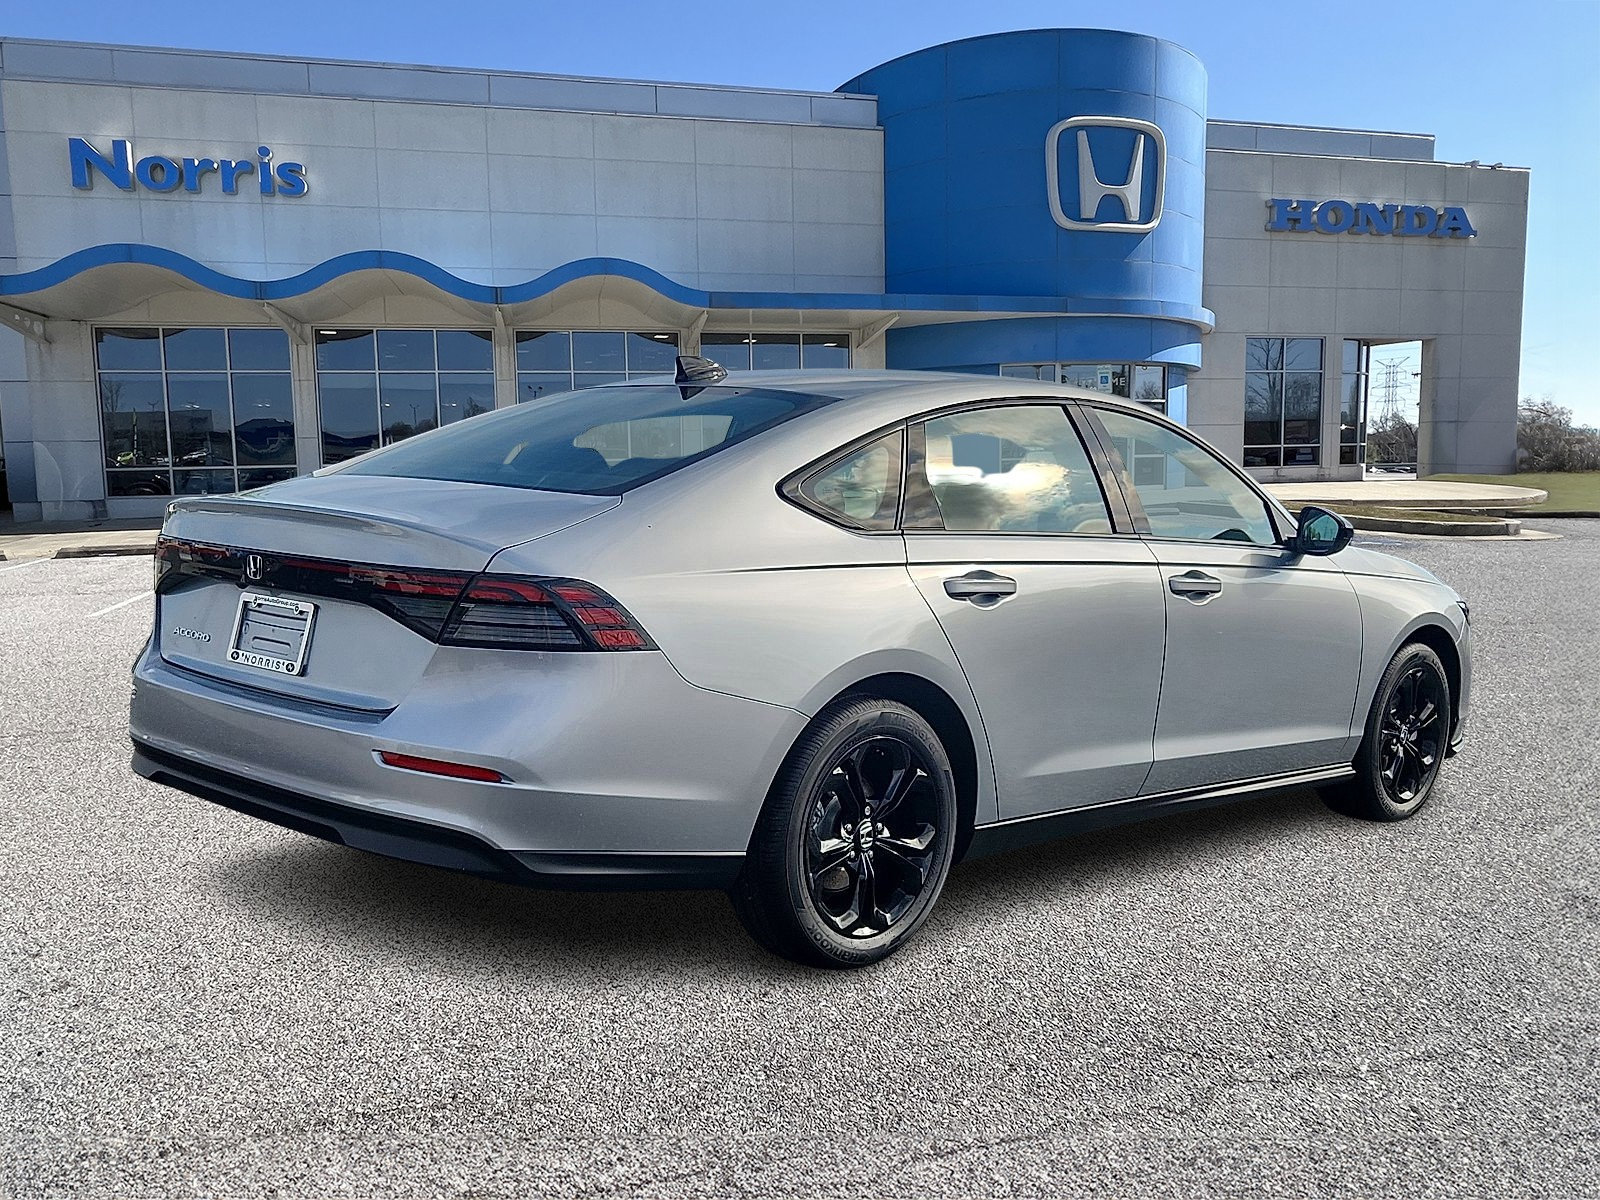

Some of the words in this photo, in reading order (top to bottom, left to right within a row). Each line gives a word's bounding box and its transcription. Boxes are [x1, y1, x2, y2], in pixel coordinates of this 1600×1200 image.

[68, 137, 310, 198] Norris
[1265, 198, 1478, 239] HONDA
[173, 626, 211, 642] ACCORD
